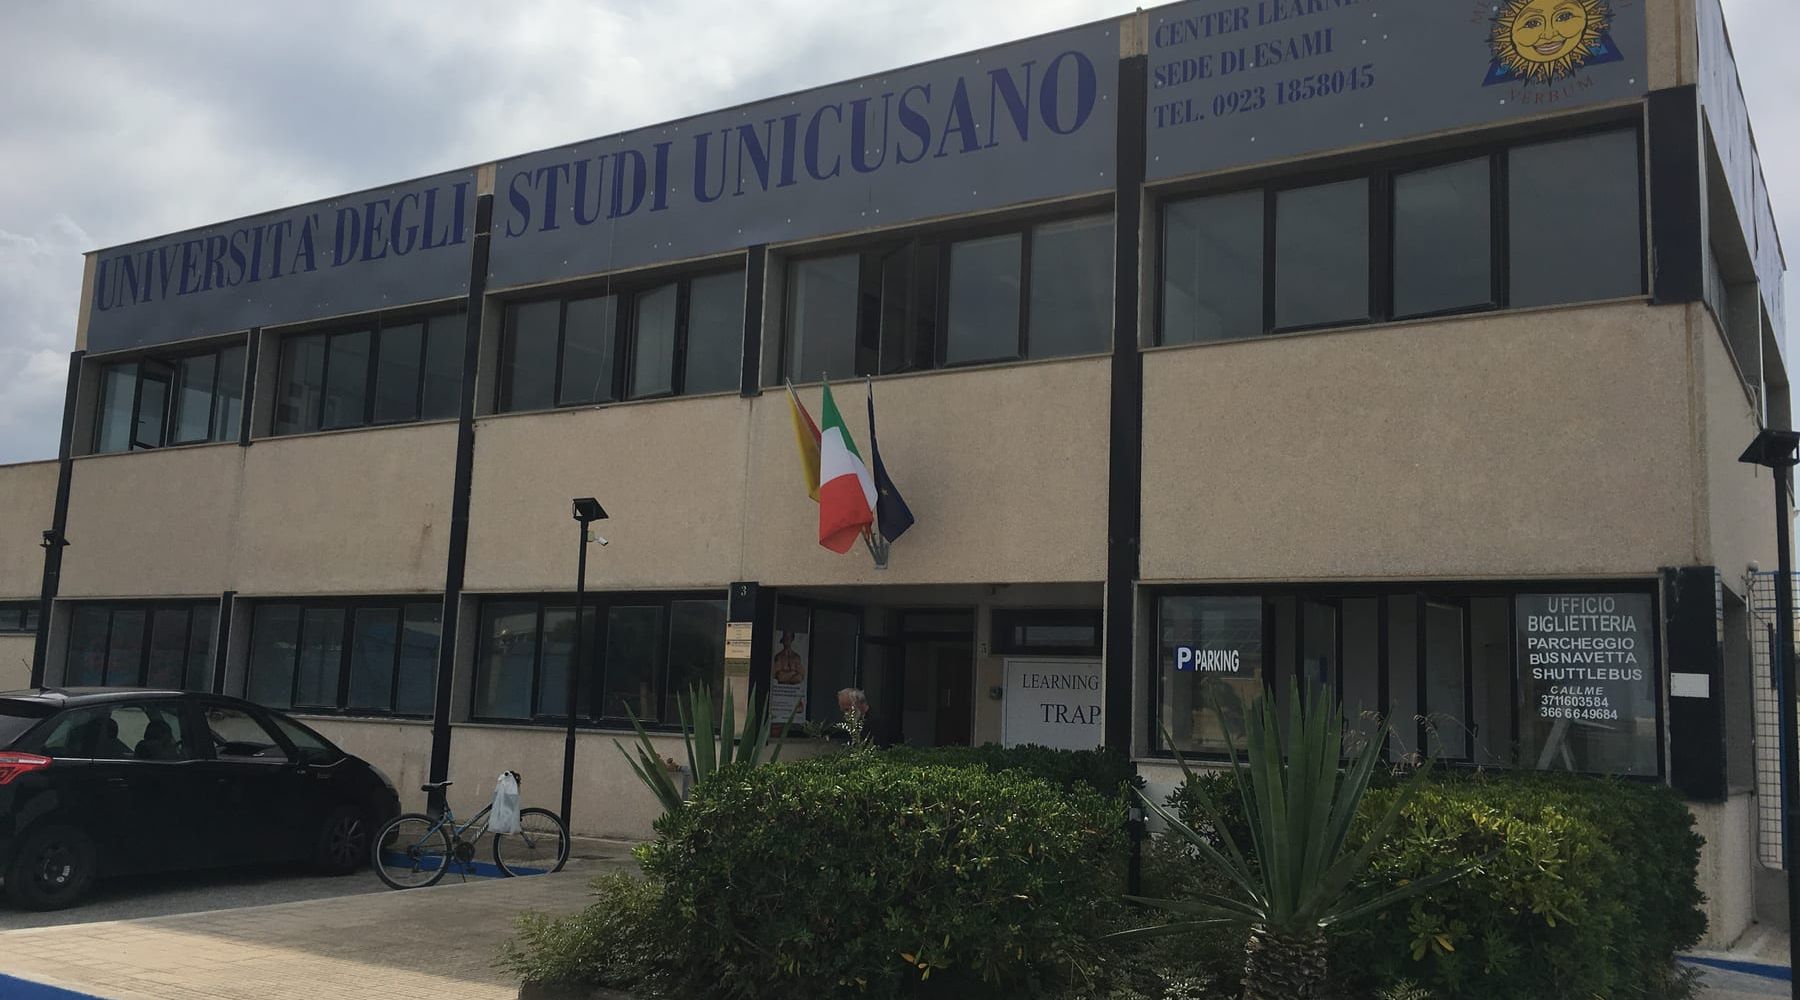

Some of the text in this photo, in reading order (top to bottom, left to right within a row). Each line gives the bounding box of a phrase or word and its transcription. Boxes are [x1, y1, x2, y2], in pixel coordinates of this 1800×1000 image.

[1155, 6, 1250, 48] CENTER
[1154, 28, 1333, 89] SEDE DI ESAMI
[1154, 64, 1375, 129] TEL. 0923 1858045
[330, 181, 470, 268] DEGLI
[505, 142, 673, 238] STUDI
[693, 50, 1097, 203] UNICUSANO
[740, 585, 747, 597] 3
[1548, 597, 1616, 614] UFFICIO
[1528, 615, 1637, 633] BIGLIETTERIA
[1528, 637, 1635, 650] PARCHEGGIO
[1194, 650, 1240, 672] PARKING
[1022, 674, 1099, 690] LEARNING
[1541, 694, 1609, 708] 3711603584
[1040, 703, 1101, 725] TRAP
